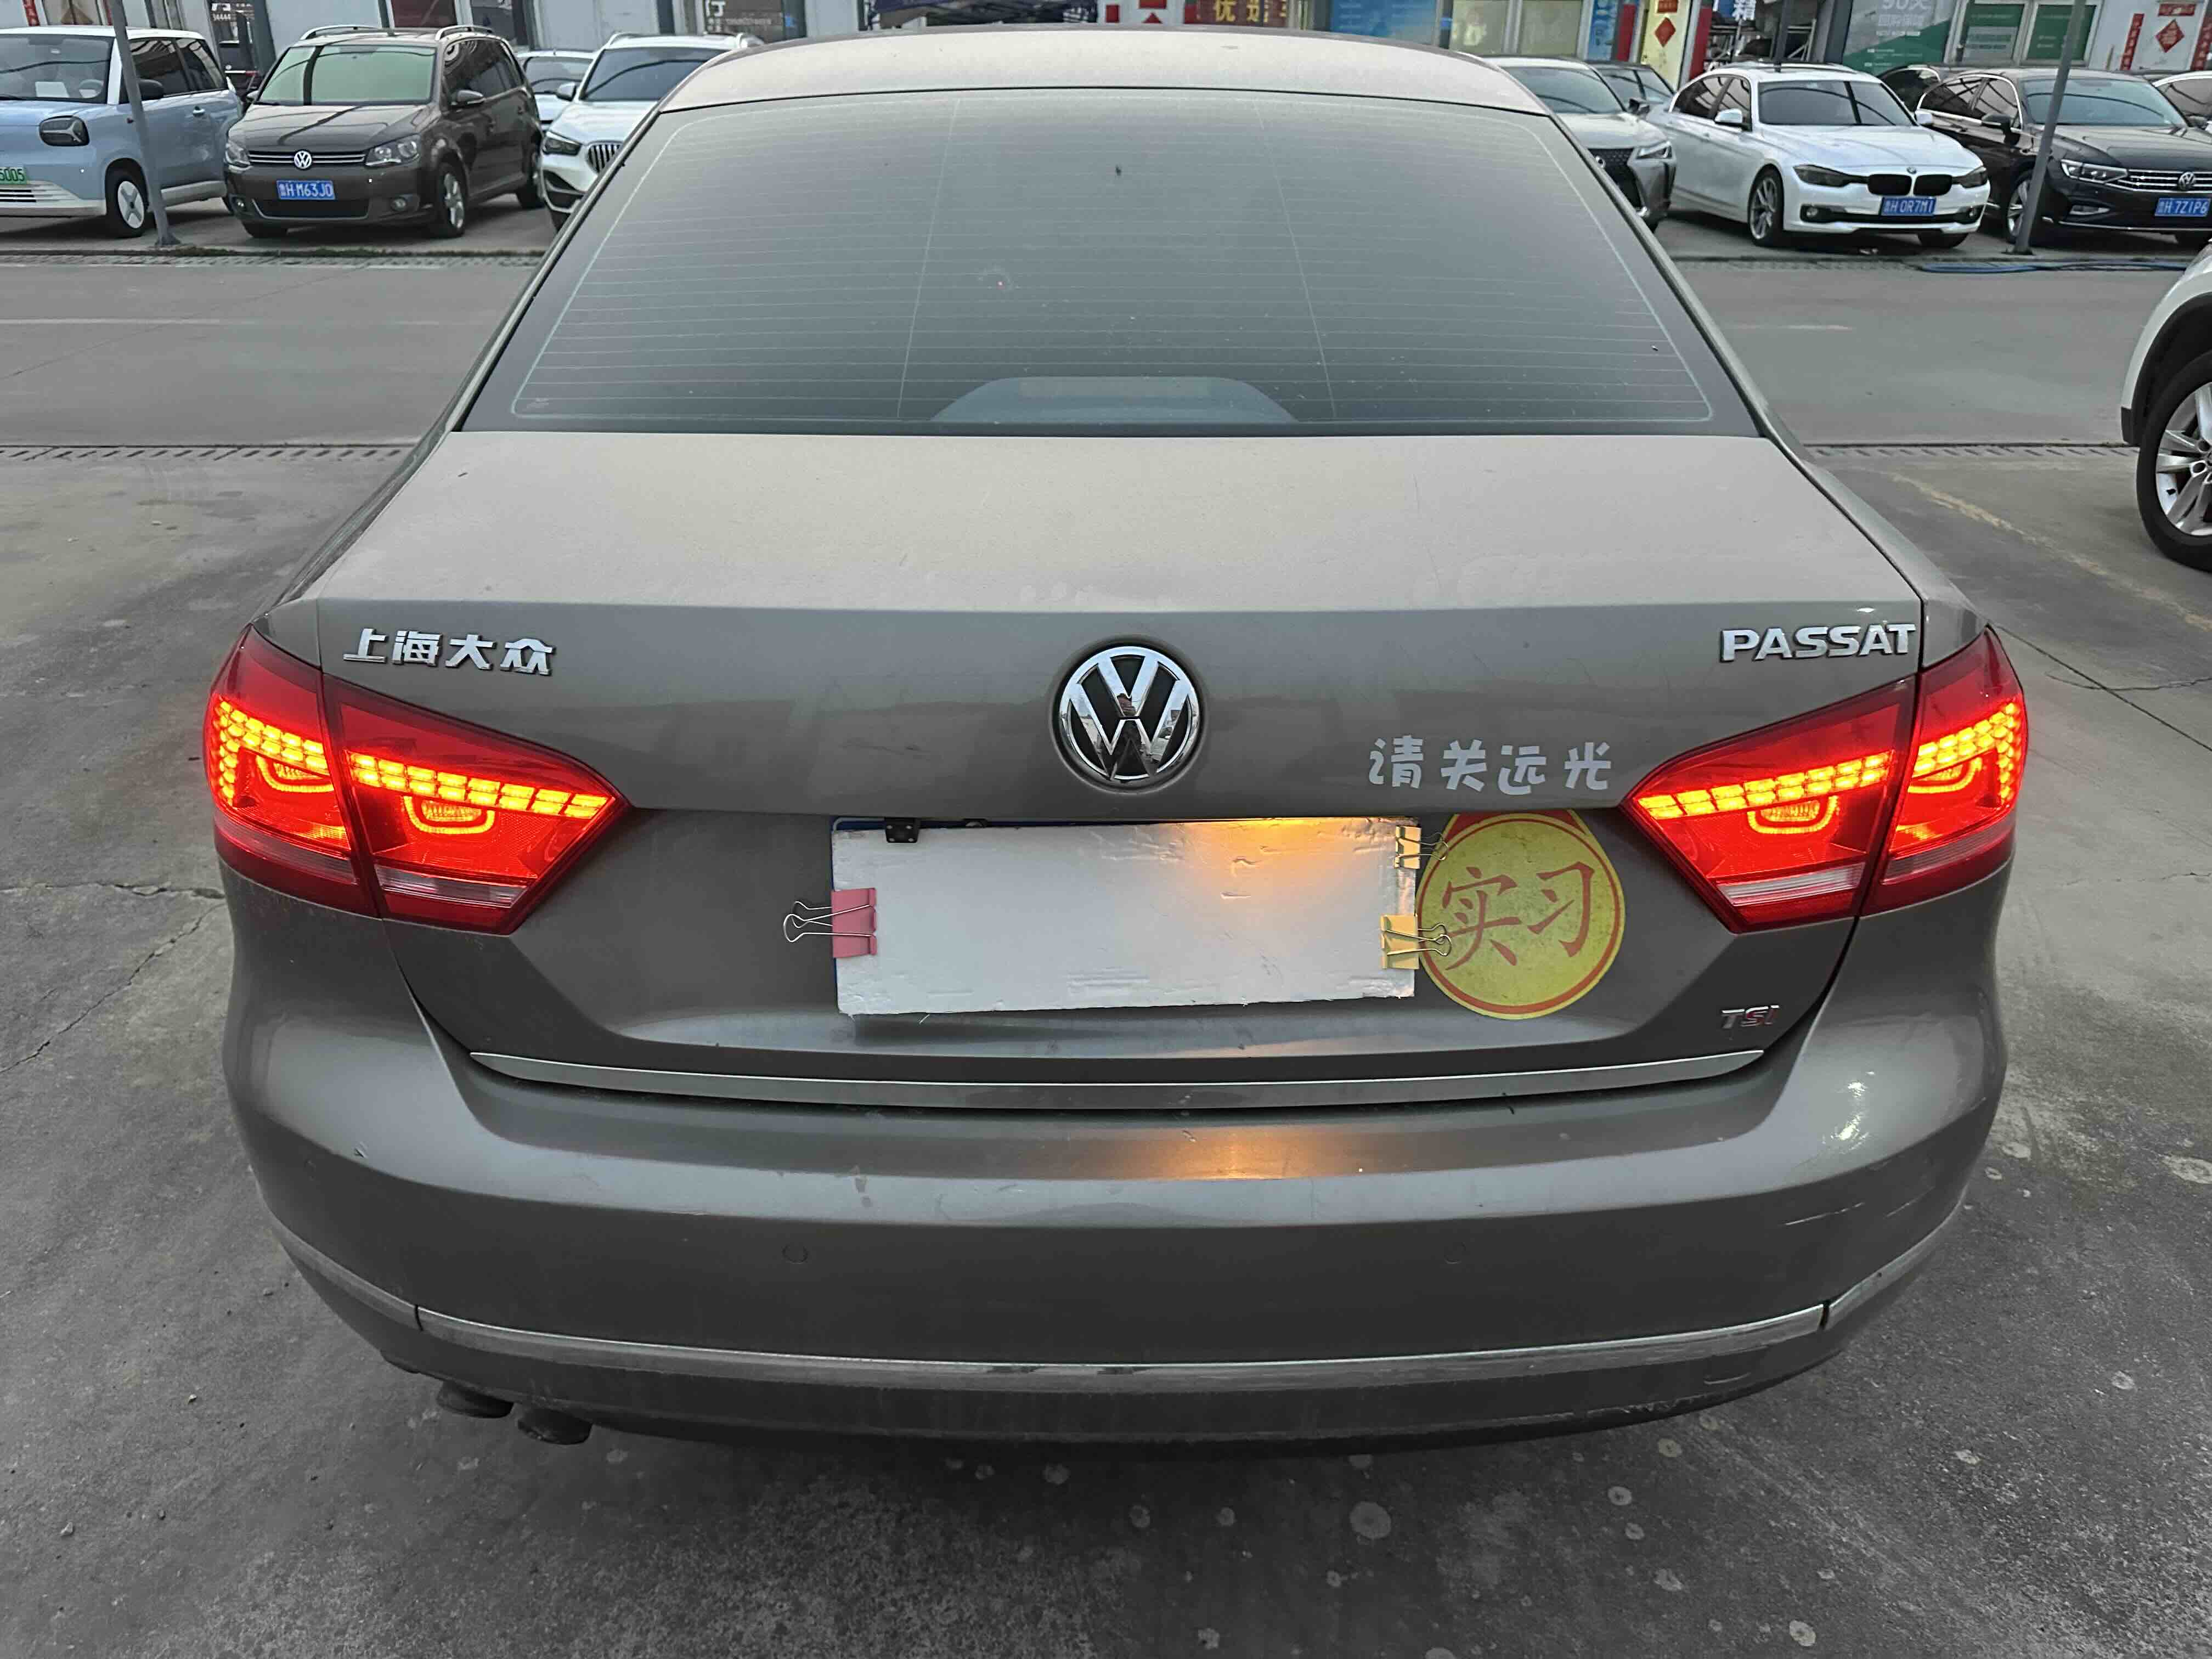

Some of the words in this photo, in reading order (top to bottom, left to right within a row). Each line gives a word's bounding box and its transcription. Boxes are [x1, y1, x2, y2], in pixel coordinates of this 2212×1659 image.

[342, 627, 555, 677] 上海大众
[1720, 623, 1918, 663] PASSAT
[1369, 735, 1611, 795] 请关远光
[1442, 860, 1595, 970] 实习
